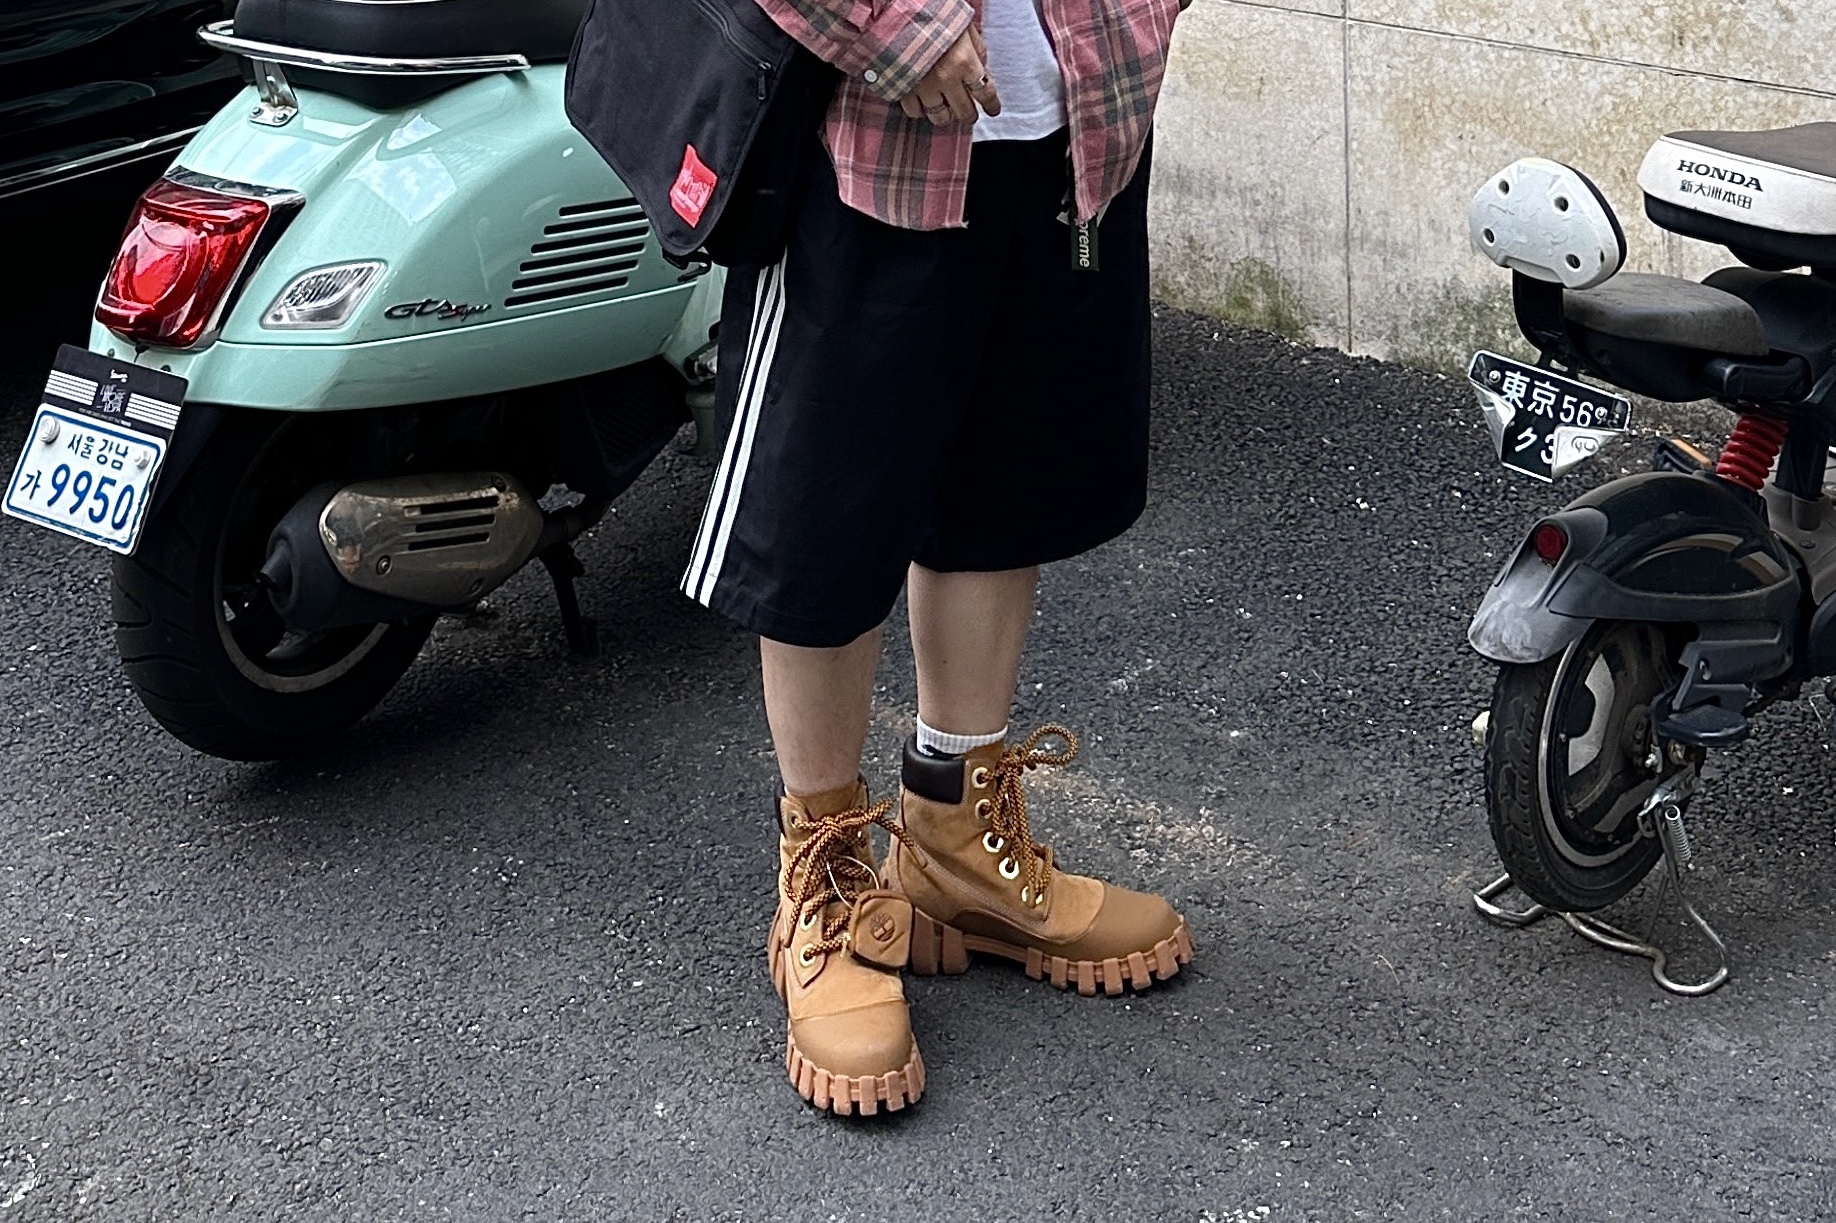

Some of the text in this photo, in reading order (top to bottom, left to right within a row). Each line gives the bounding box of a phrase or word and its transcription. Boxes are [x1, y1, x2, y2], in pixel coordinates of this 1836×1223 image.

[1677, 159, 1764, 192] HONDA
[1679, 178, 1753, 210] 新大洲本田
[20, 463, 135, 530] 가 9950
